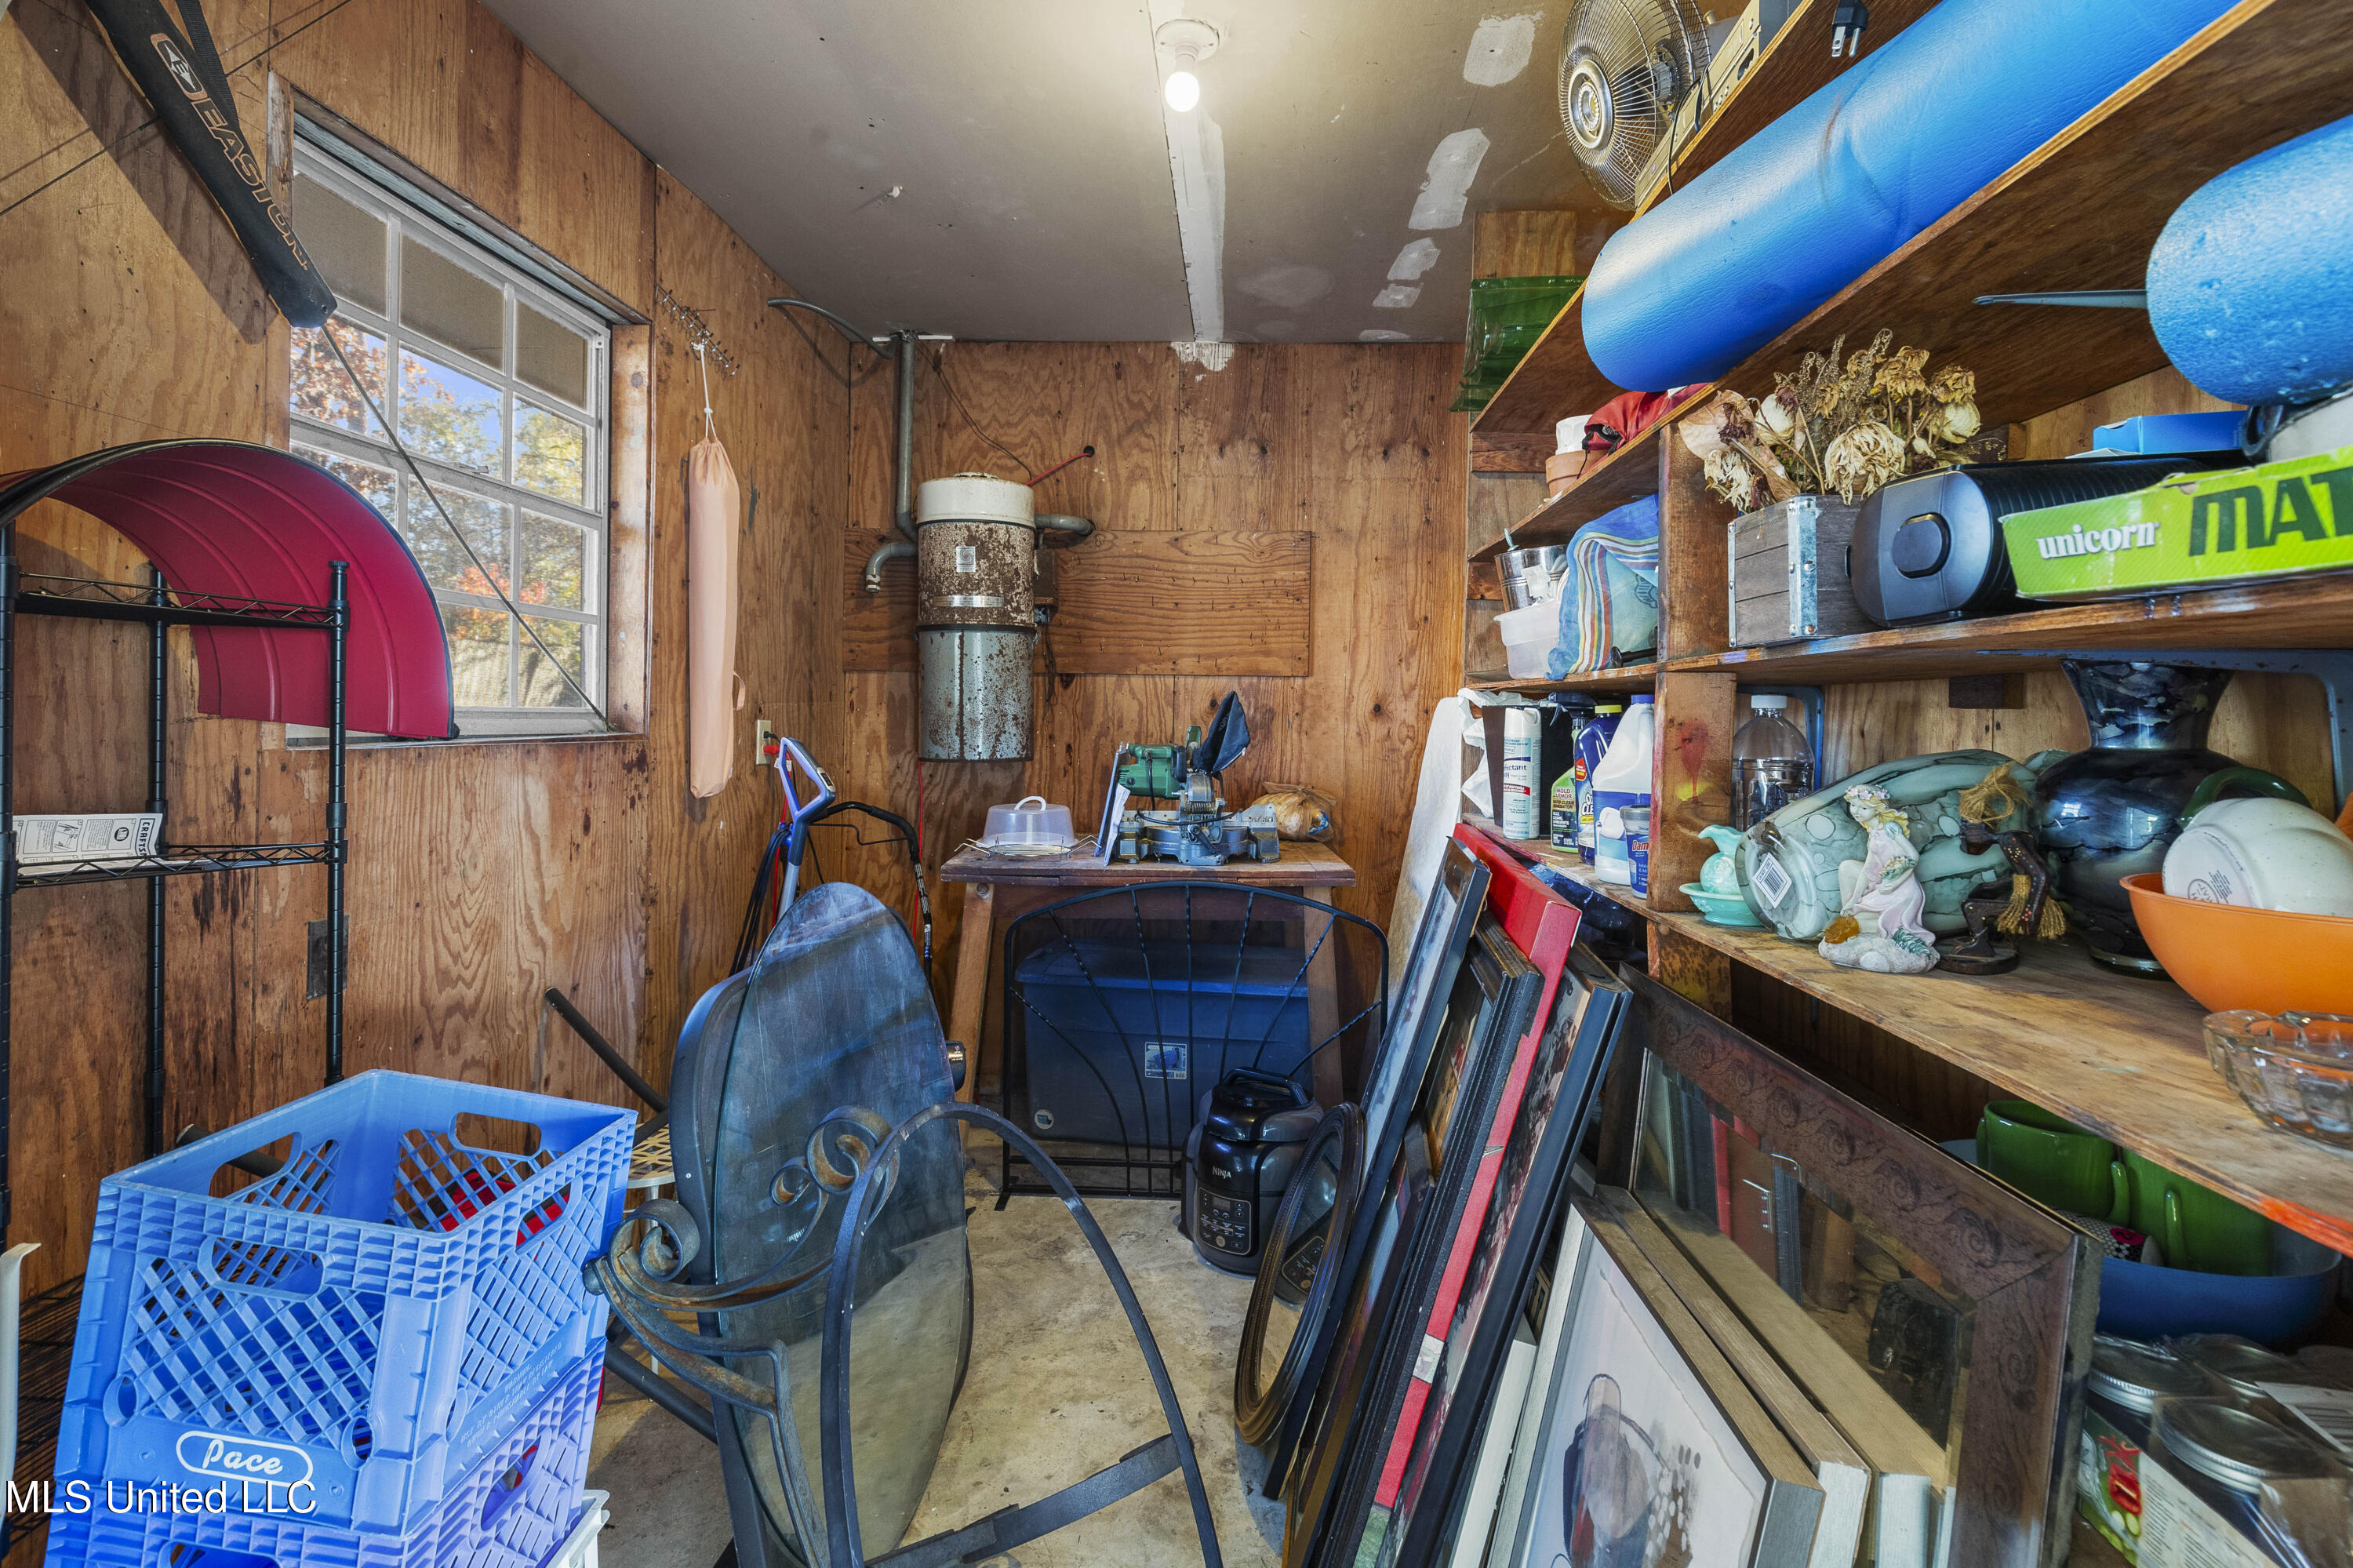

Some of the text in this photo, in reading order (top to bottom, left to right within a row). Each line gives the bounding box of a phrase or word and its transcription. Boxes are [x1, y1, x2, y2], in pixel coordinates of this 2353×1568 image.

[191, 97, 307, 268] EASTON
[2037, 523, 2157, 560] unicorn
[1213, 1166, 1231, 1179] NINJA
[201, 1439, 284, 1476] Pace
